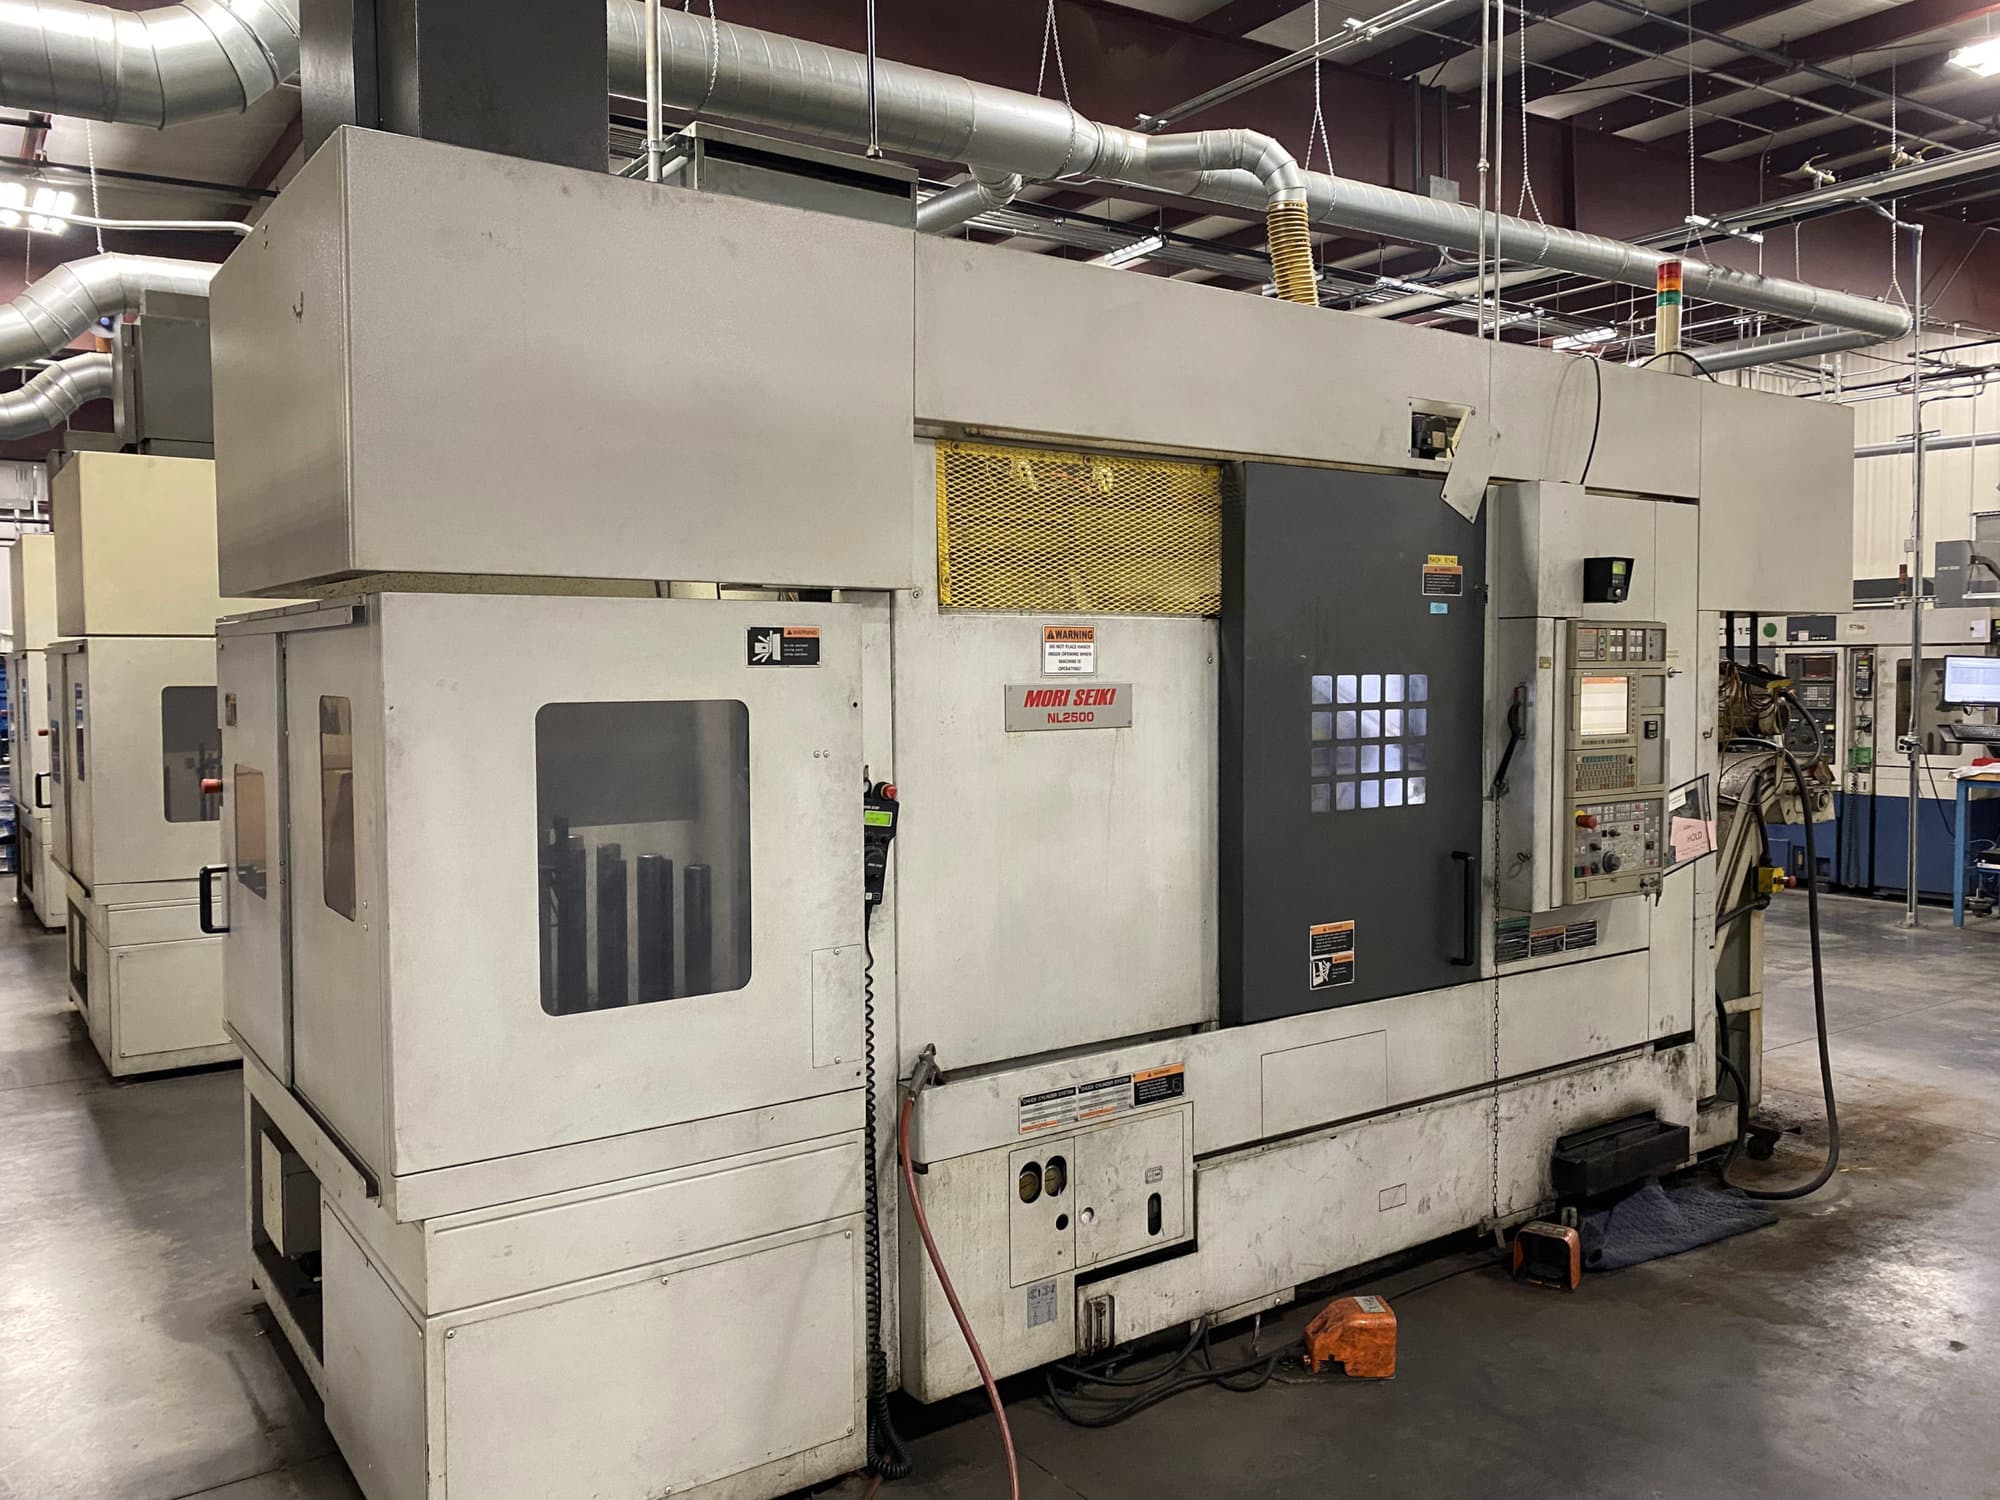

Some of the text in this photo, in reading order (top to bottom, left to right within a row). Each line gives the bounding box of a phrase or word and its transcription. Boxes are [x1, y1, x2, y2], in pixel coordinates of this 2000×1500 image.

[1055, 629, 1093, 640] WARNING
[1024, 688, 1116, 708] MORI SEIKI
[1047, 712, 1094, 724] NL2500
[1687, 831, 1702, 843] HOLD
